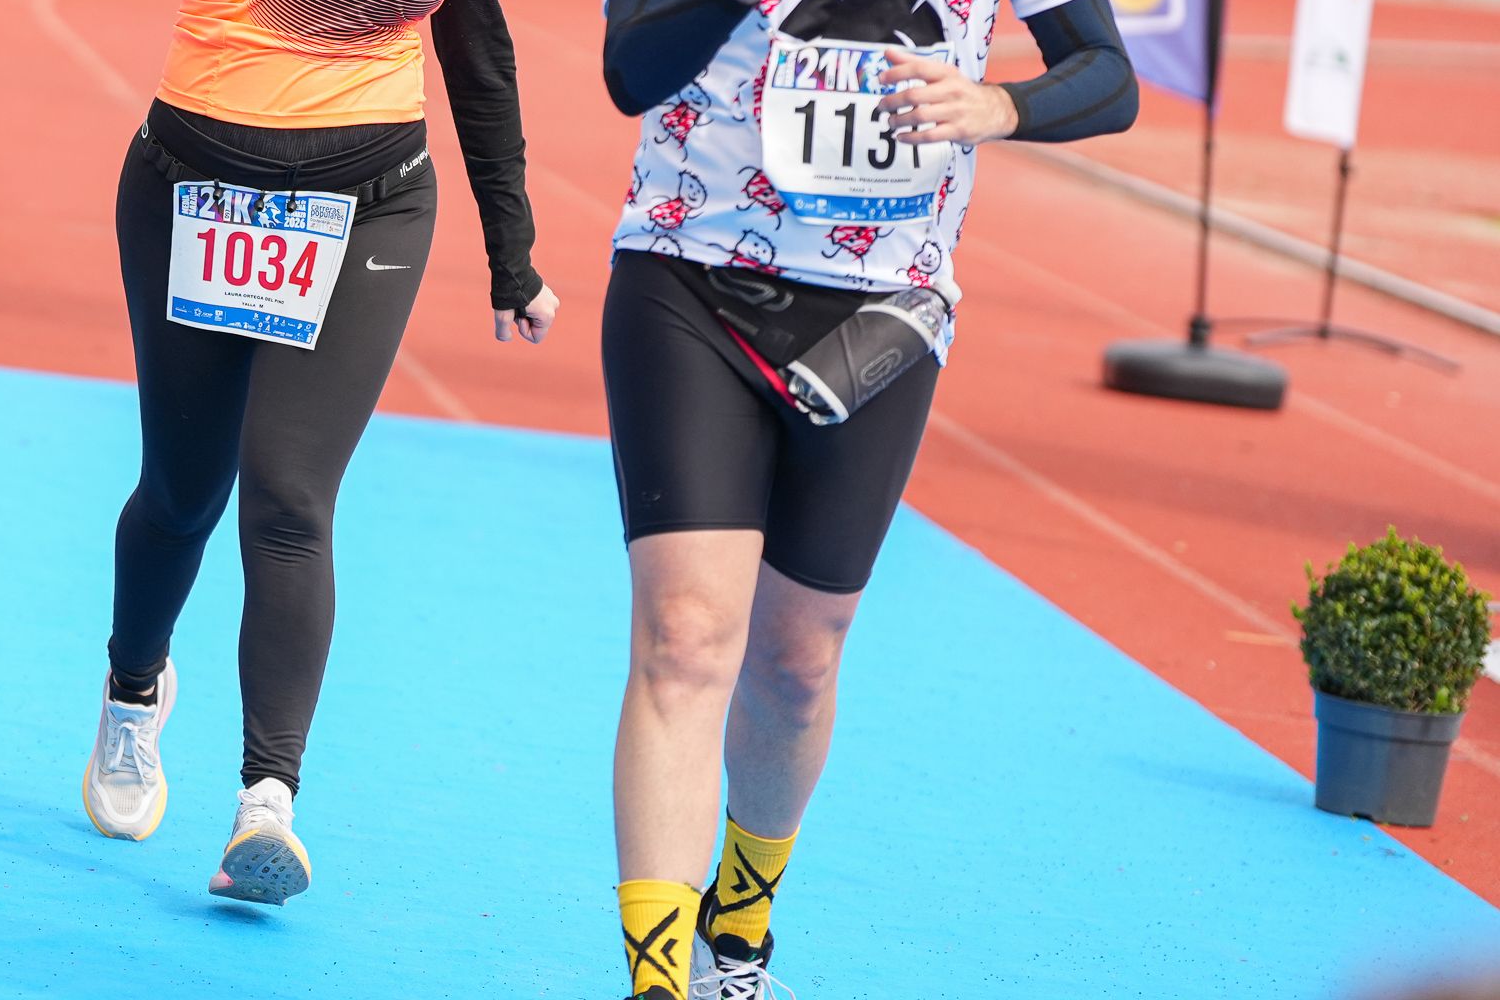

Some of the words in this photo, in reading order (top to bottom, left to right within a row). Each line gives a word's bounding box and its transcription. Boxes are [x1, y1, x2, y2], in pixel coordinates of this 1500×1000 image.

[795, 47, 862, 93] 21K
[198, 186, 253, 224] 21K
[310, 209, 345, 222] populares
[283, 216, 306, 229] 2026
[197, 227, 319, 297] 1034
[243, 293, 264, 301] ORTEGA
